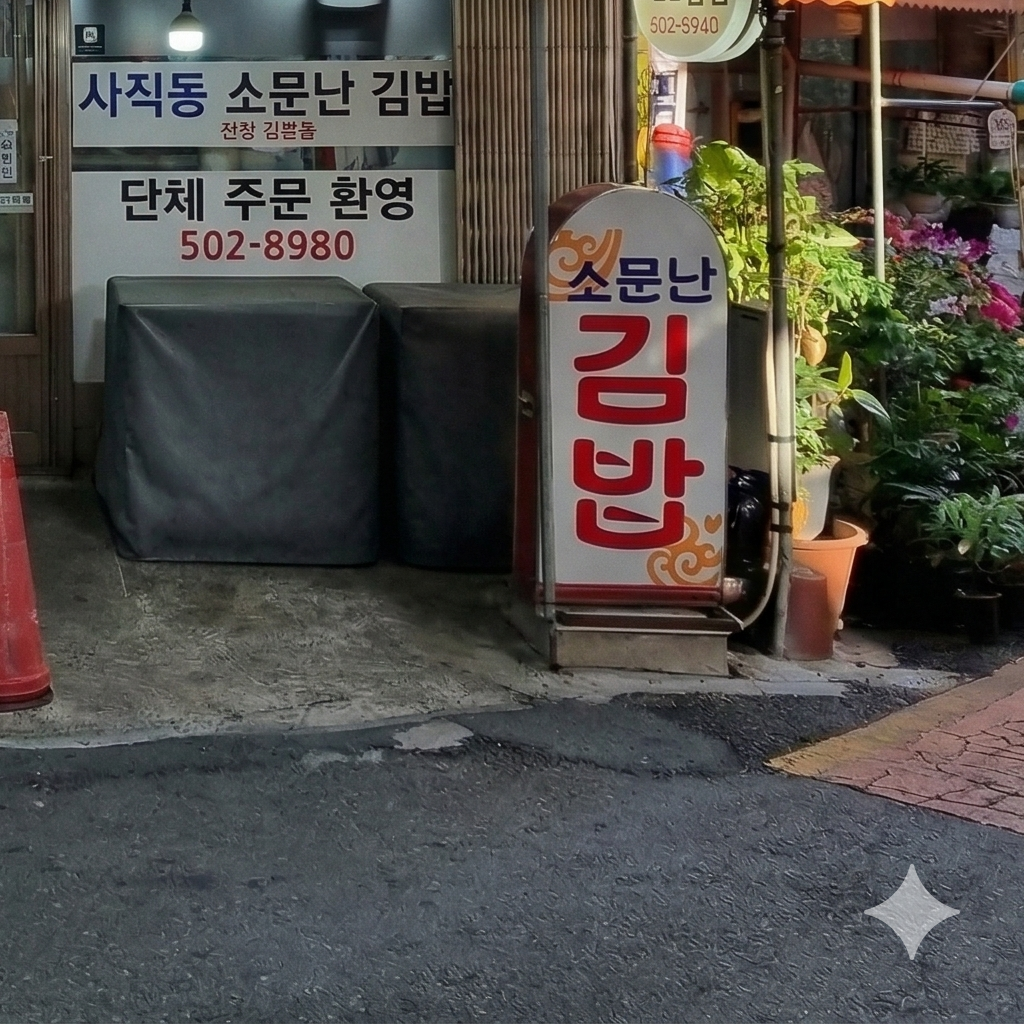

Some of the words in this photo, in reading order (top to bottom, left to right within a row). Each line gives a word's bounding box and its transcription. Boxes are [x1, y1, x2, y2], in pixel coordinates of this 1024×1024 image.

[78, 71, 208, 118] 사직동
[225, 71, 355, 117] 소문난
[372, 70, 453, 117] 김밥
[121, 177, 205, 222] 단체
[224, 178, 312, 222] 주문
[329, 176, 415, 221] 환영
[180, 229, 355, 262] 502-8980
[567, 256, 717, 304] 소문난
[573, 314, 705, 550] 김밥
